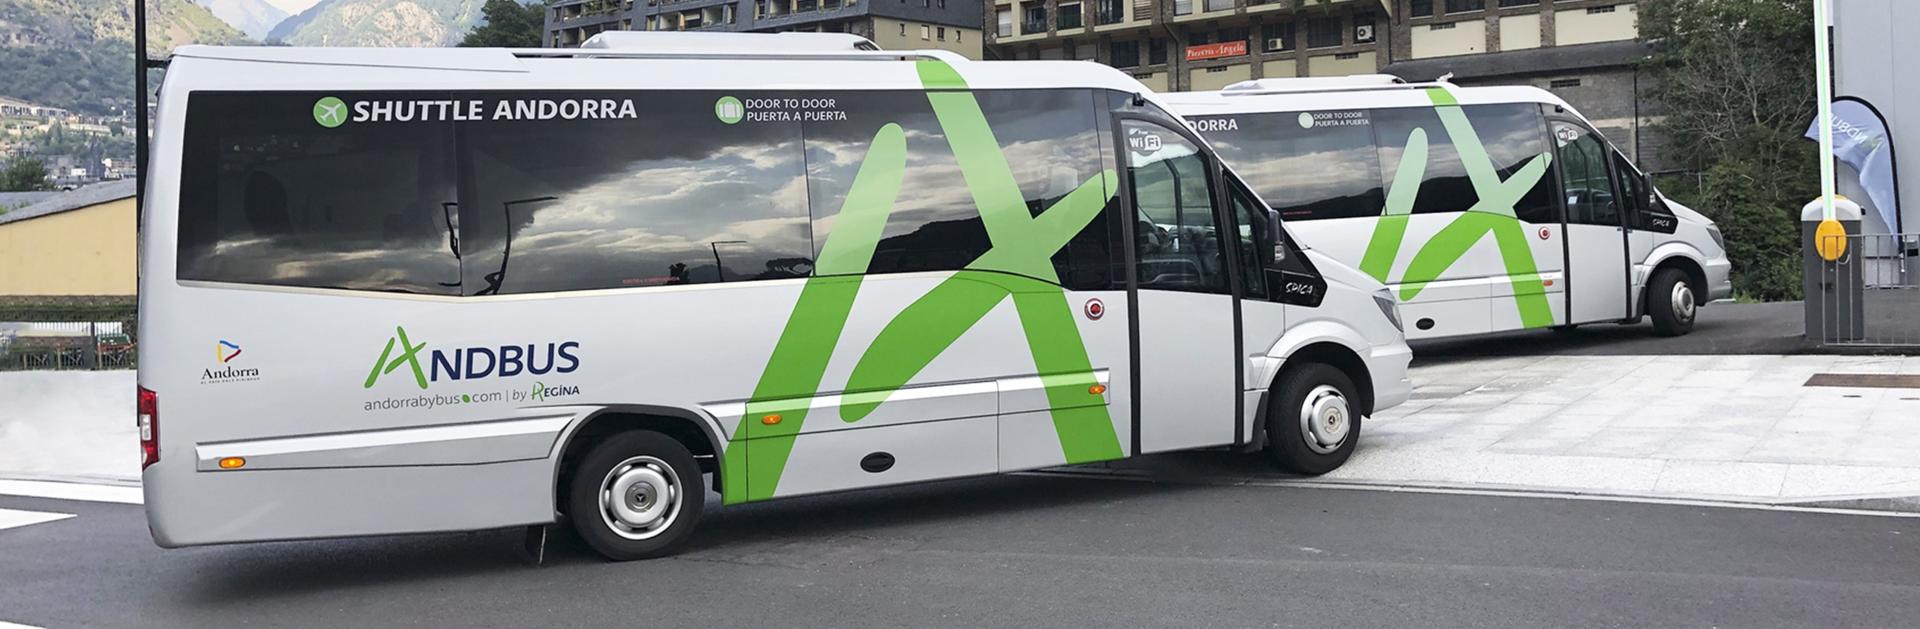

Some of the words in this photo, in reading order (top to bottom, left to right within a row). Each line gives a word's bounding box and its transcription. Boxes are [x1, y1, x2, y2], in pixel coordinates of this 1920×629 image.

[353, 100, 483, 122] SHUTTLE
[492, 99, 637, 120] ANDORRA
[745, 98, 781, 109] DOOR
[783, 98, 799, 109] TO
[801, 98, 836, 109] DOOR
[746, 111, 790, 121] PUERTA
[793, 111, 802, 121] A
[804, 111, 847, 121] PUERTA
[1186, 118, 1238, 131] DORRA
[364, 326, 580, 389] ANDBUS
[201, 366, 259, 380] Andorra
[512, 389, 527, 403] by
